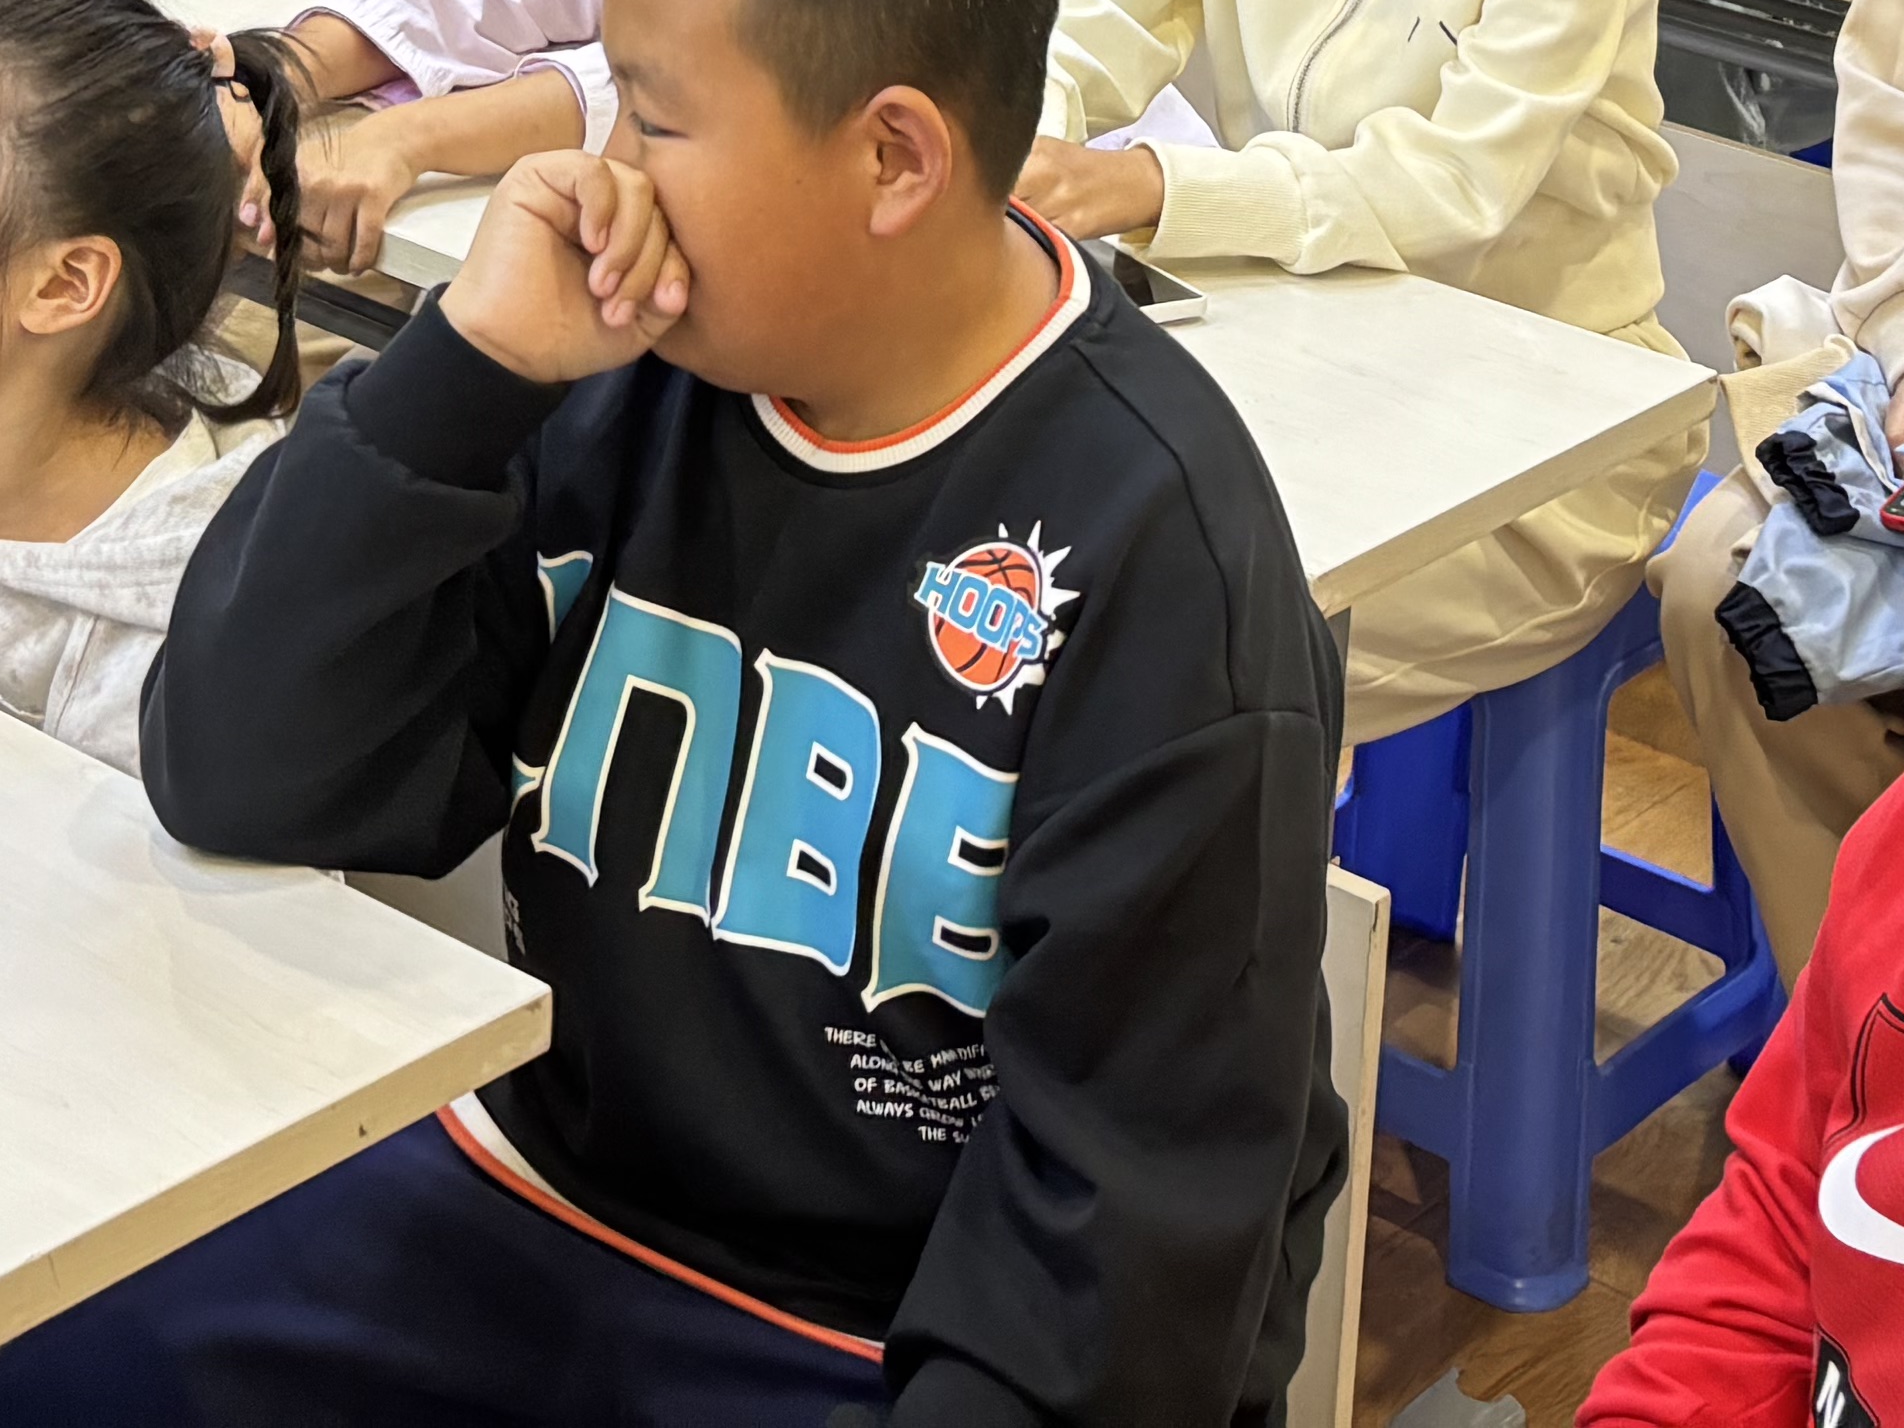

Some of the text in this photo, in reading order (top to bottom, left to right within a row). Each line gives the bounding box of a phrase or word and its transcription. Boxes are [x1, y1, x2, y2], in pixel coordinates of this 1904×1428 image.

[917, 562, 1050, 662] HOOPS
[824, 1026, 877, 1047] THERE
[853, 1077, 878, 1093] OF
[927, 1072, 962, 1093] WAY
[856, 1099, 914, 1119] ALWAYS
[918, 1125, 947, 1142] THE
